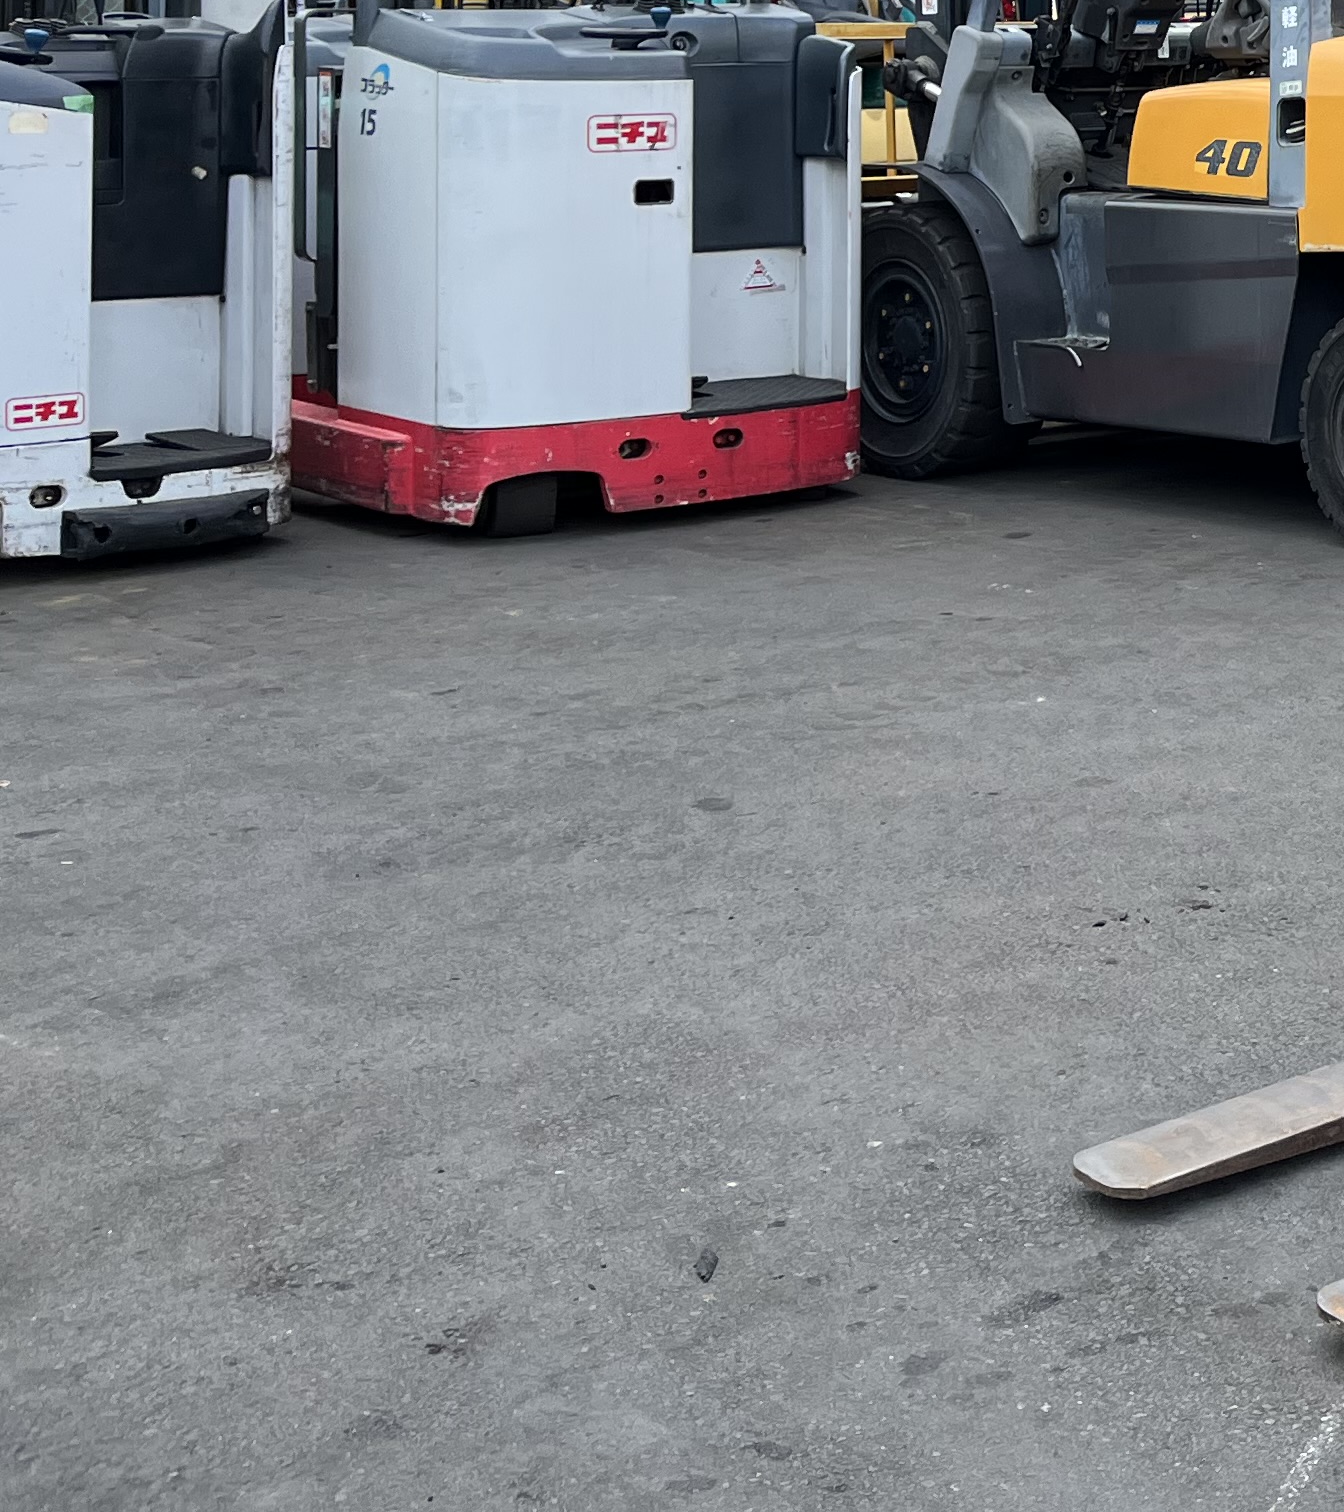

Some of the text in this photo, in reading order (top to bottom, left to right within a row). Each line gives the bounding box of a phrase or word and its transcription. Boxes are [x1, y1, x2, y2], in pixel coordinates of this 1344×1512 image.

[1281, 5, 1298, 68] 軽油
[360, 108, 377, 136] 15
[1195, 139, 1262, 178] 40
